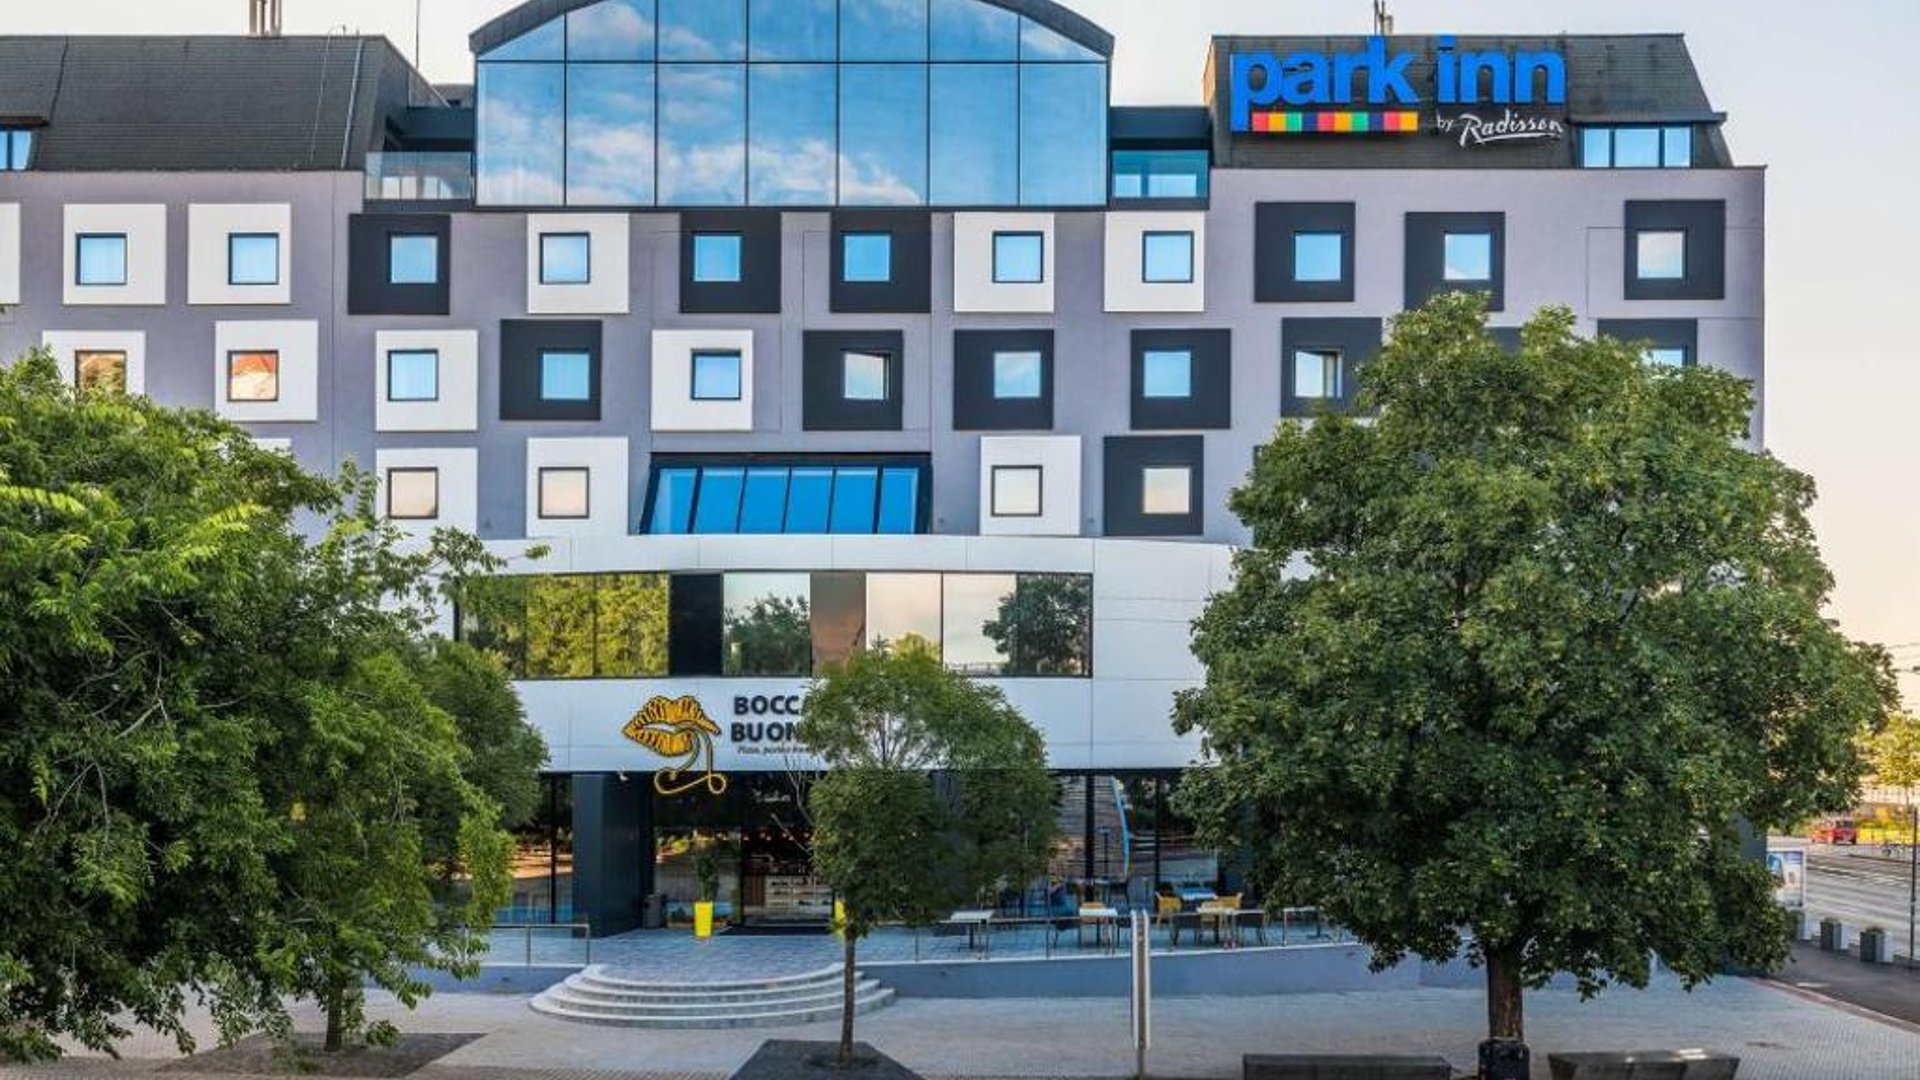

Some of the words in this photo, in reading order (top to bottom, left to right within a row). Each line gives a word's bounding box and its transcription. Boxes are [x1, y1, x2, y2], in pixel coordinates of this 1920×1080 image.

[1230, 35, 1420, 132] park
[1437, 35, 1567, 105] inn
[1436, 114, 1454, 133] by
[1459, 109, 1564, 147] Radisson
